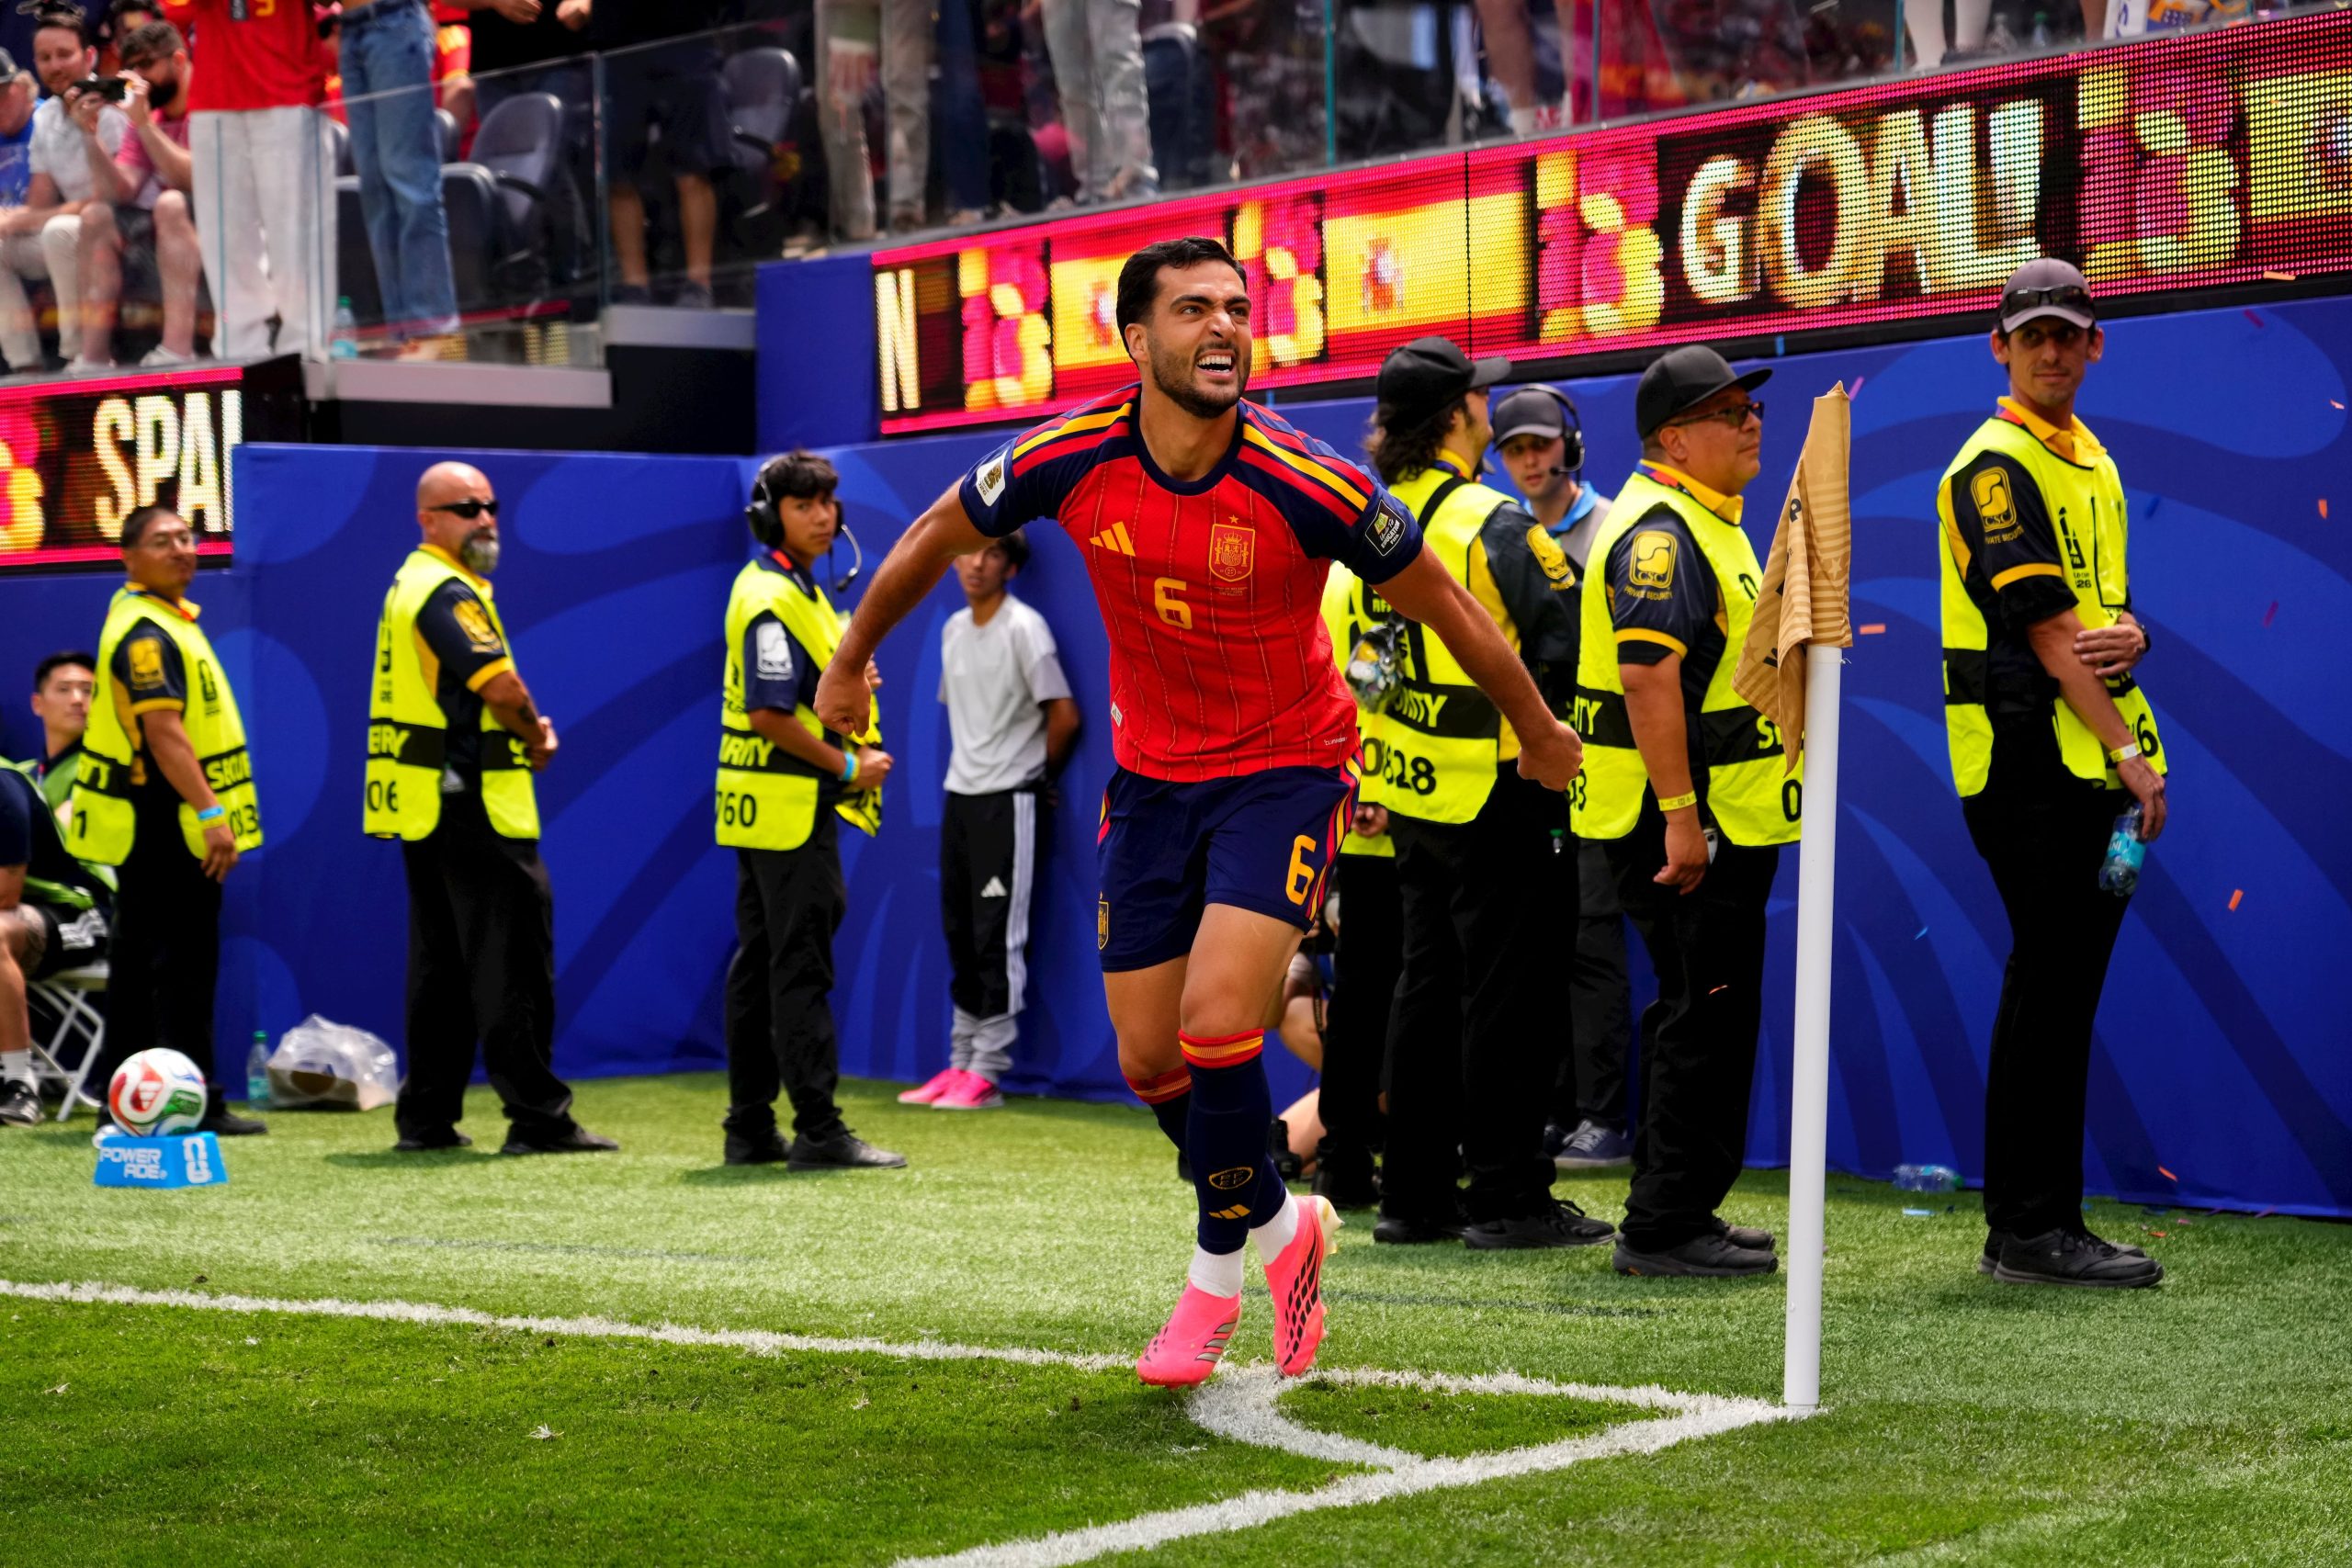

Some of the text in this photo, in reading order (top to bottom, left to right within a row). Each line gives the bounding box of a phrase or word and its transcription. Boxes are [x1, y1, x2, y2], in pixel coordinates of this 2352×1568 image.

[876, 268, 920, 412] N
[1154, 577, 1193, 630] 6
[1286, 834, 1317, 906] 6
[99, 1147, 163, 1165] POWER
